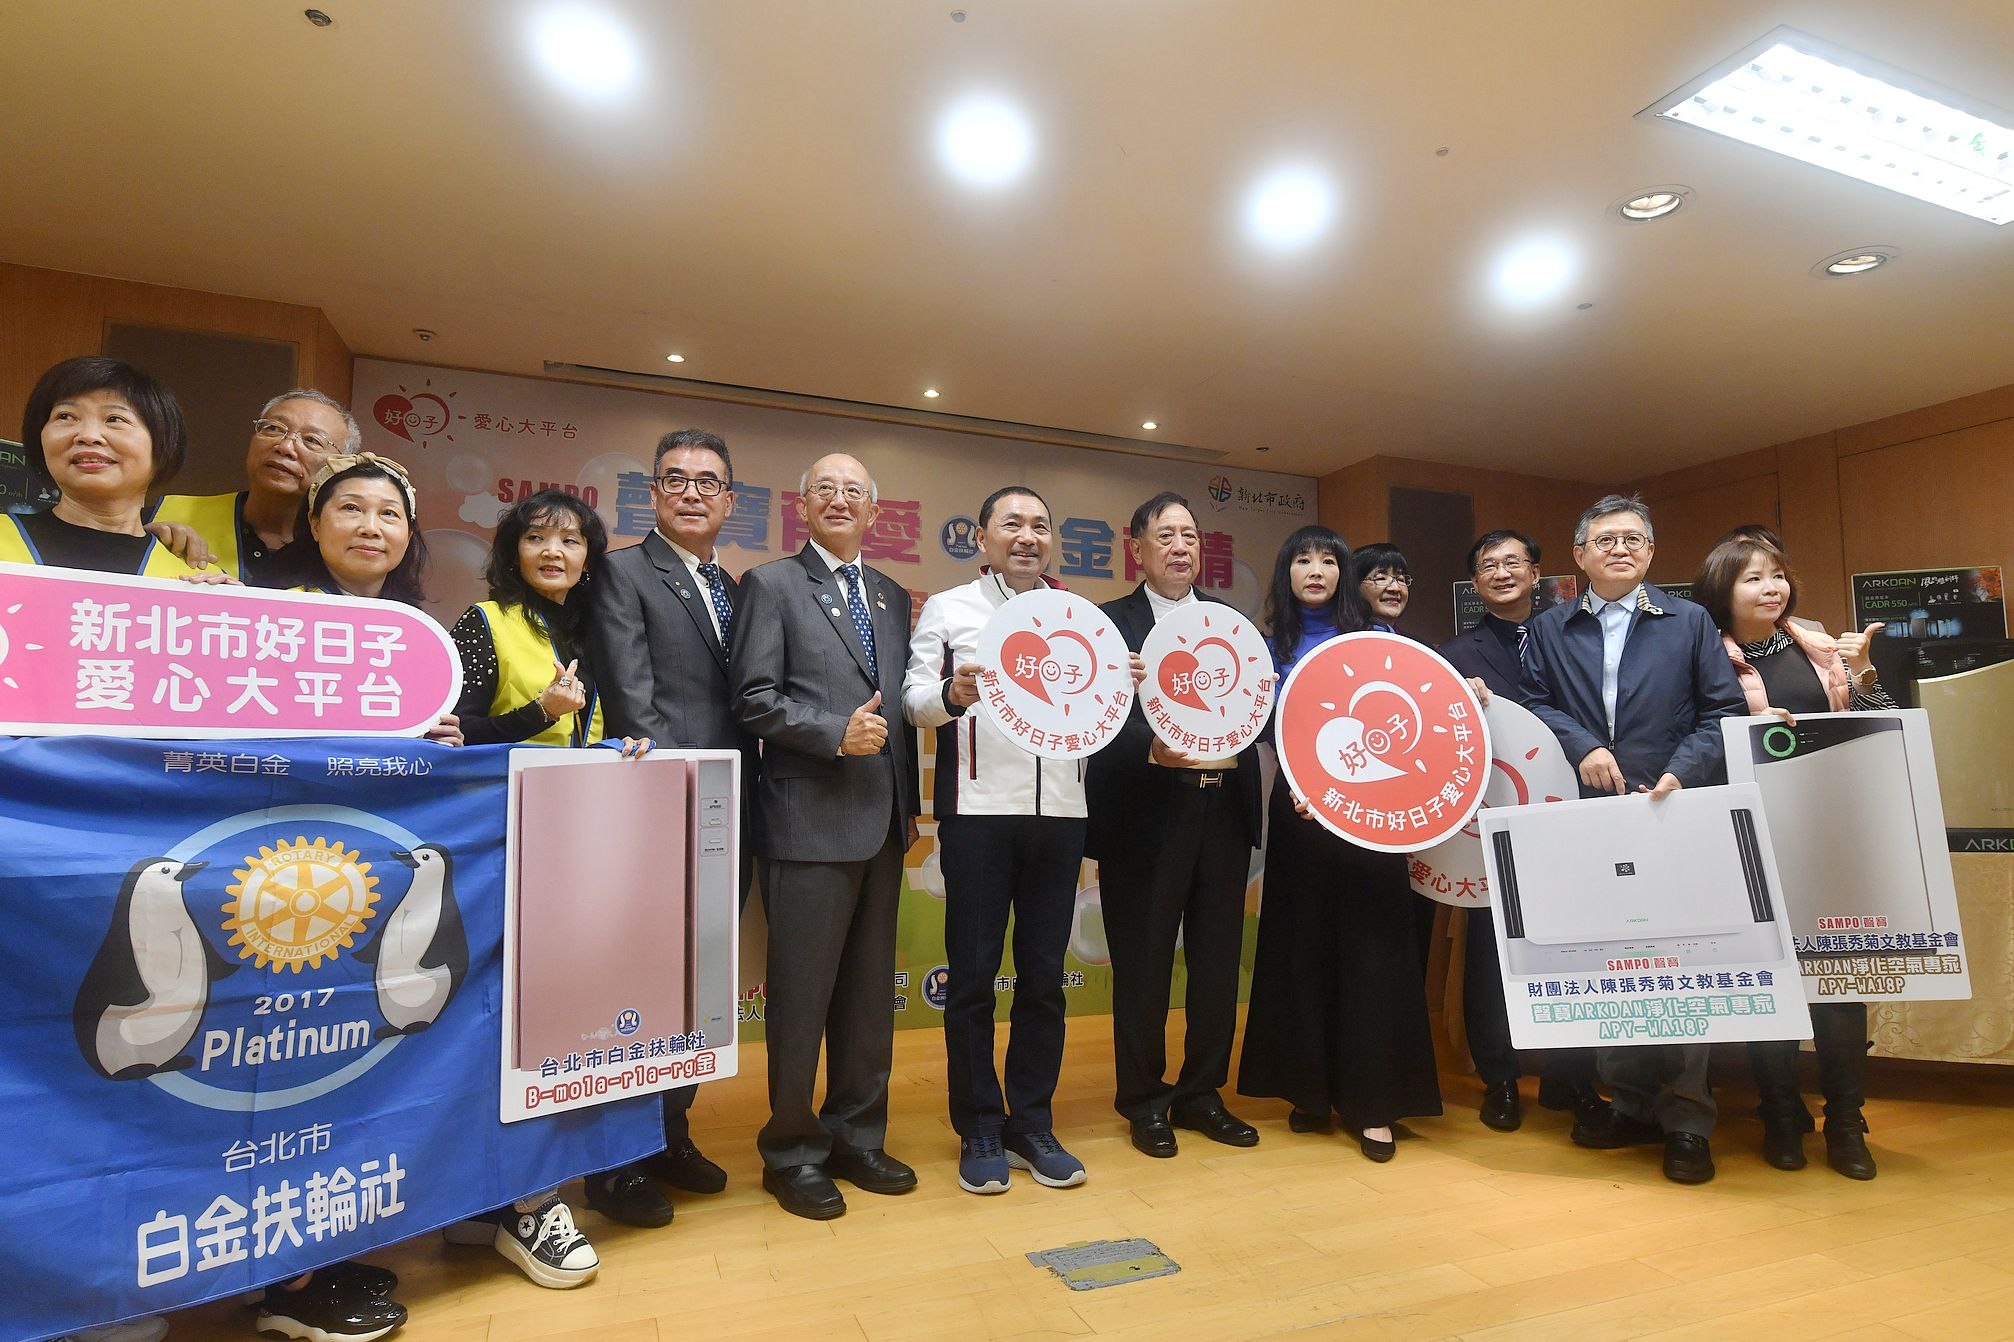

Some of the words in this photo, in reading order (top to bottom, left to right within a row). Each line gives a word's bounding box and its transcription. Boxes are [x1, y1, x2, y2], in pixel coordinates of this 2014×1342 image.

[474, 413, 578, 439] 愛心大平台
[1238, 487, 1305, 511] 新北市政府
[1862, 577, 1917, 588] ARKDAN
[1865, 600, 1890, 609] CADR
[70, 598, 407, 669] 新北市好日子
[75, 658, 403, 718] 愛心大平台
[982, 669, 1129, 752] 新北市好日子愛心大平台
[1146, 678, 1271, 753] 新北市好日子愛心大平台
[163, 751, 291, 776] 菁英白金
[326, 756, 433, 777] 照亮我心
[1321, 701, 1475, 831] 新北市好日子愛心大平台
[271, 850, 336, 867] ROTARY
[1819, 917, 1859, 929] SAMPO
[245, 919, 356, 958] INTERNATIONAL
[1607, 958, 1650, 971] SAMPO
[1528, 970, 1774, 998] 財團法人陳張秀菊文教基金會
[1818, 976, 1906, 995] APY-WA18P
[253, 988, 335, 1016] 2017
[1599, 1018, 1709, 1040] APY-WA18P
[200, 1018, 370, 1071] Platinum
[540, 1032, 706, 1078] 台北市白金扶輪社
[222, 1122, 333, 1173] 台北市
[136, 1153, 406, 1288] 白金扶輪社
